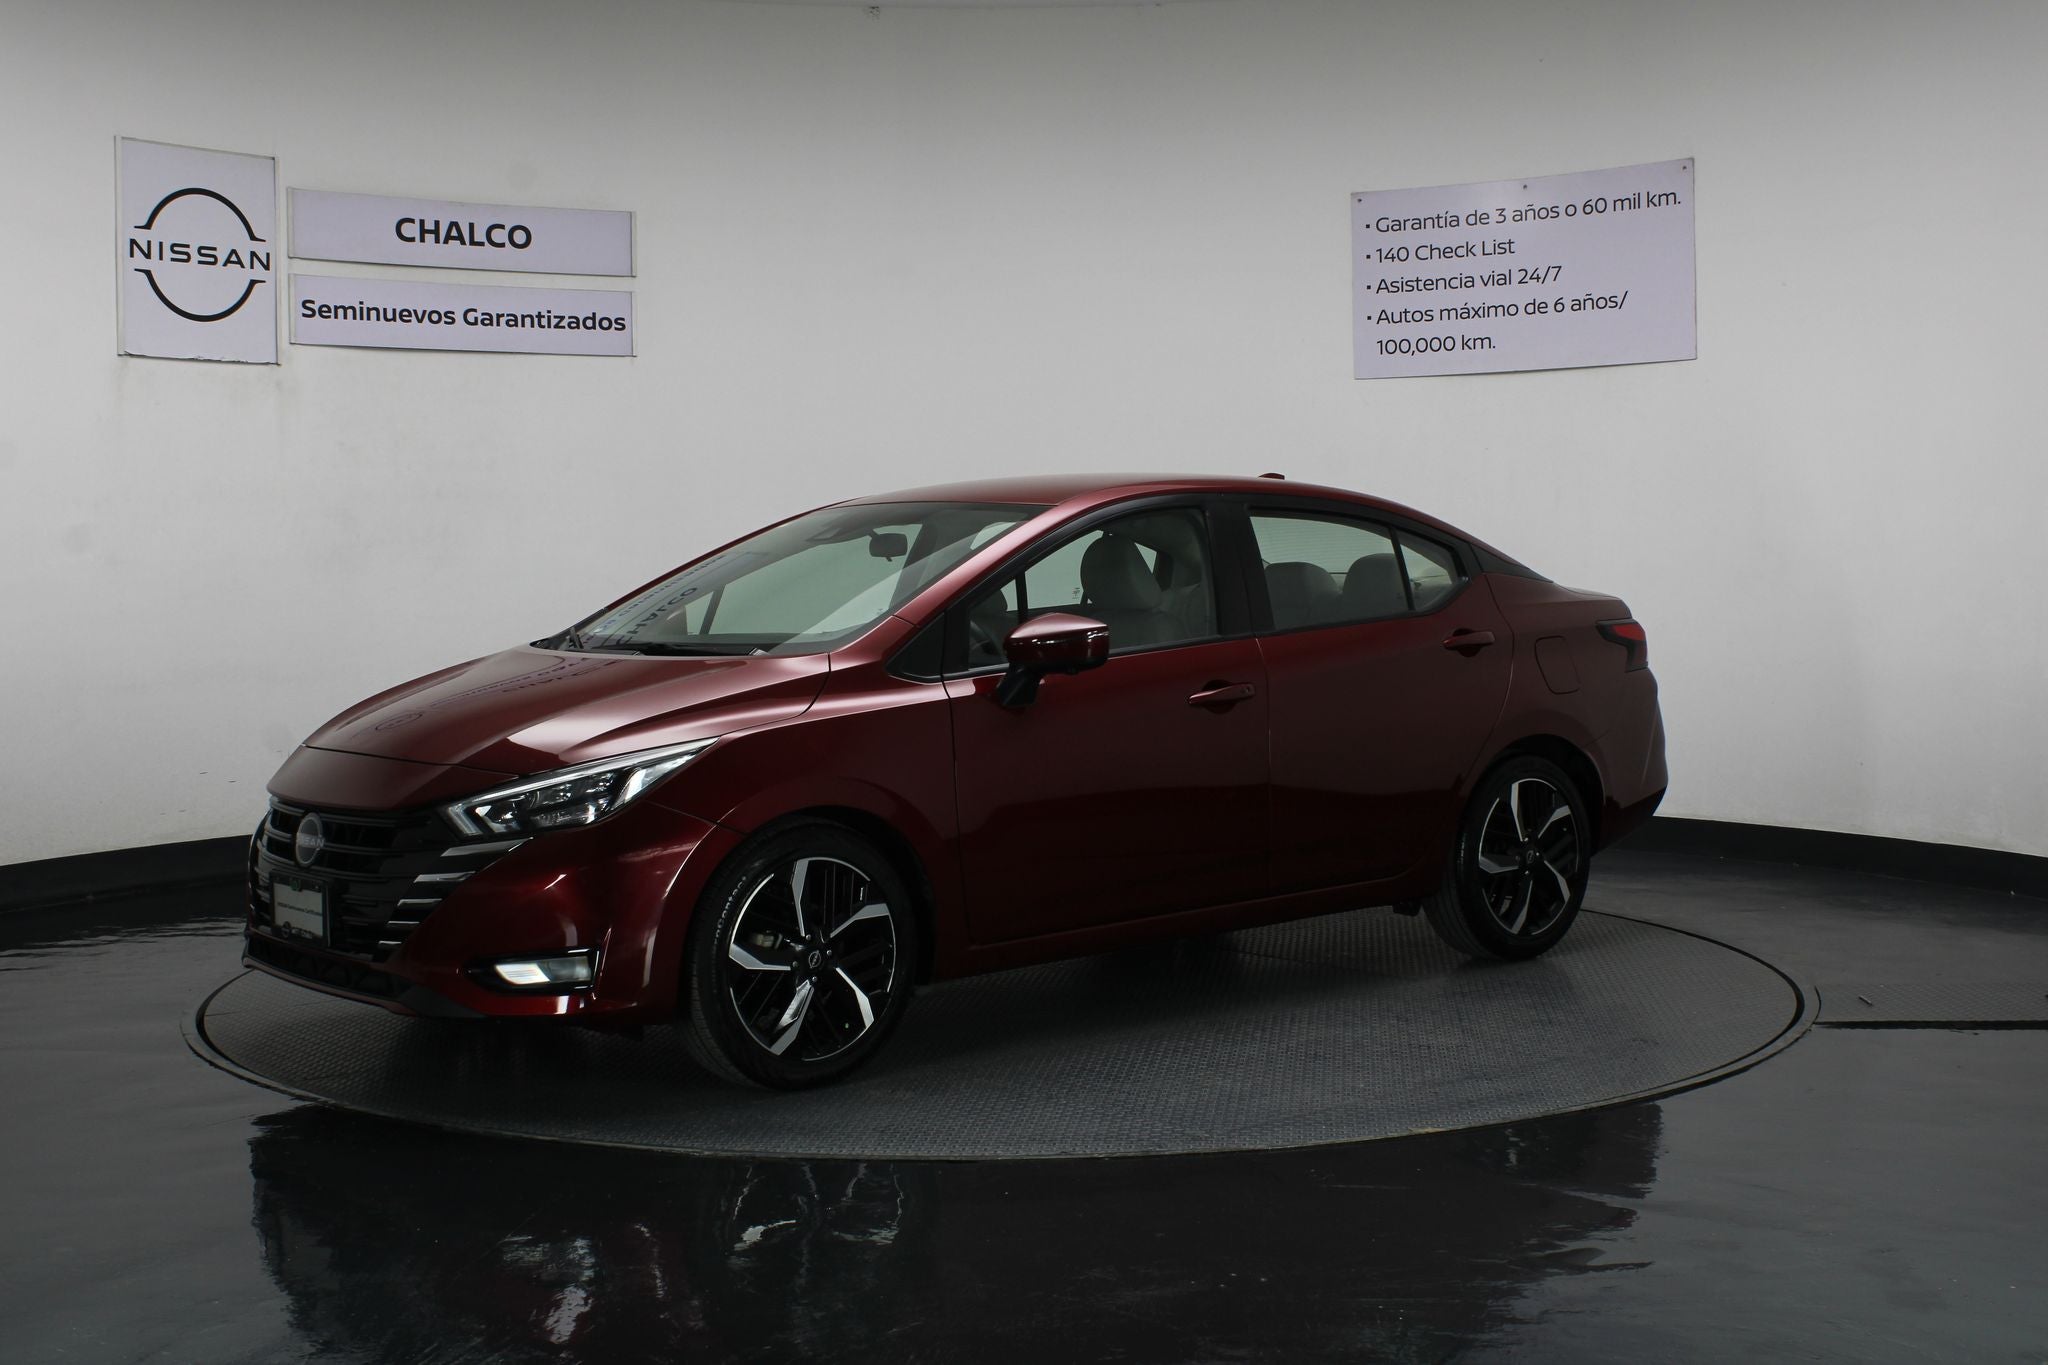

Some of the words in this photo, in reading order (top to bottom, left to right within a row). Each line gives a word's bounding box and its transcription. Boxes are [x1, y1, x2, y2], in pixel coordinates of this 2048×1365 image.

[1375, 210, 1460, 233] Garantía
[1465, 209, 1490, 227] de
[1495, 207, 1507, 224] 3
[1512, 203, 1560, 223] años
[1564, 203, 1578, 218] o
[1582, 197, 1608, 216] 60
[1612, 191, 1641, 213] mil
[1646, 190, 1682, 209] km.
[395, 217, 533, 250] CHALCO
[129, 238, 271, 272] NISSAN
[1375, 246, 1410, 264] 140
[1414, 240, 1477, 261] Check
[1481, 238, 1516, 257] List
[1375, 272, 1475, 295] Asistencia
[1479, 268, 1512, 288] vial
[1517, 265, 1563, 285] 24/7
[301, 299, 456, 326] Seminuevos
[462, 307, 627, 332] Garantizados
[1375, 307, 1435, 325] Autos
[1439, 301, 1519, 322] máximo
[1523, 297, 1549, 316] de
[1553, 296, 1566, 314] 6
[1570, 290, 1629, 312] años/
[1376, 335, 1456, 357] 100,000
[1461, 334, 1496, 351] km.
